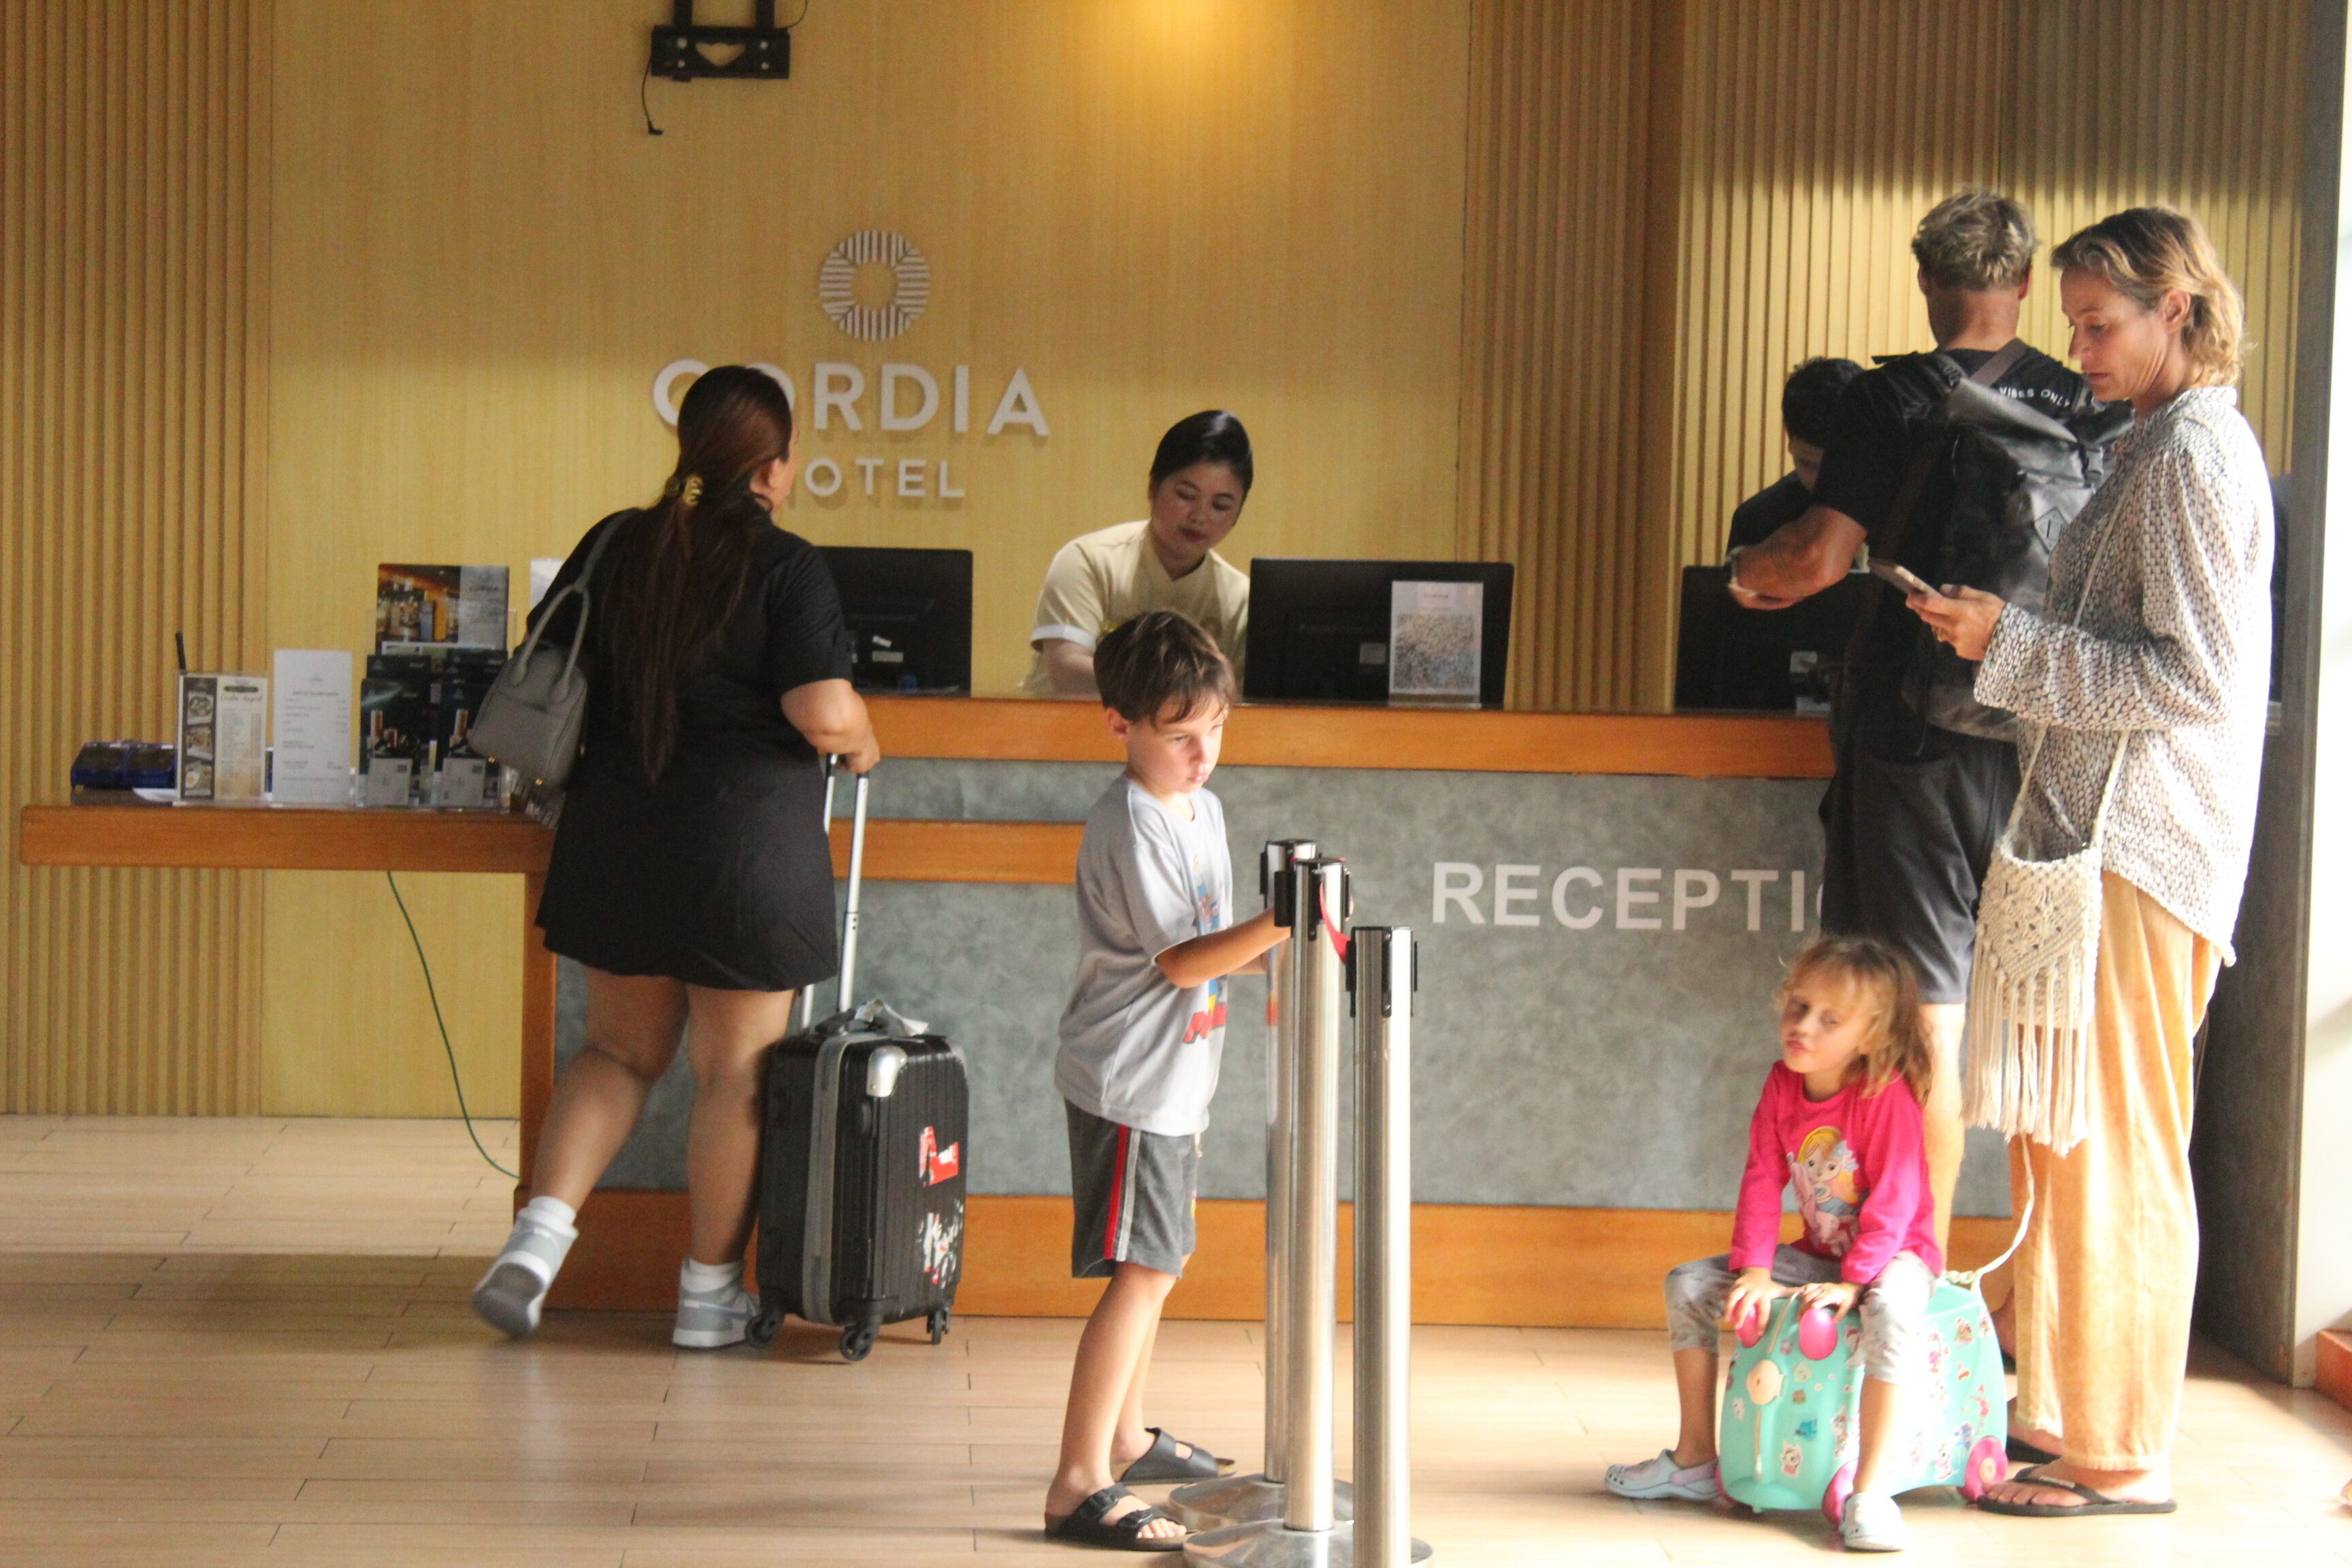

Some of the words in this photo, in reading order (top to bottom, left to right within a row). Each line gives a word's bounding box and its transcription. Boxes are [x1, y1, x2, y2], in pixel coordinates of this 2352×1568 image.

[2041, 389, 2070, 408] ONLY
[804, 457, 966, 497] OTEL
[1432, 862, 1824, 932] RECEPTI
